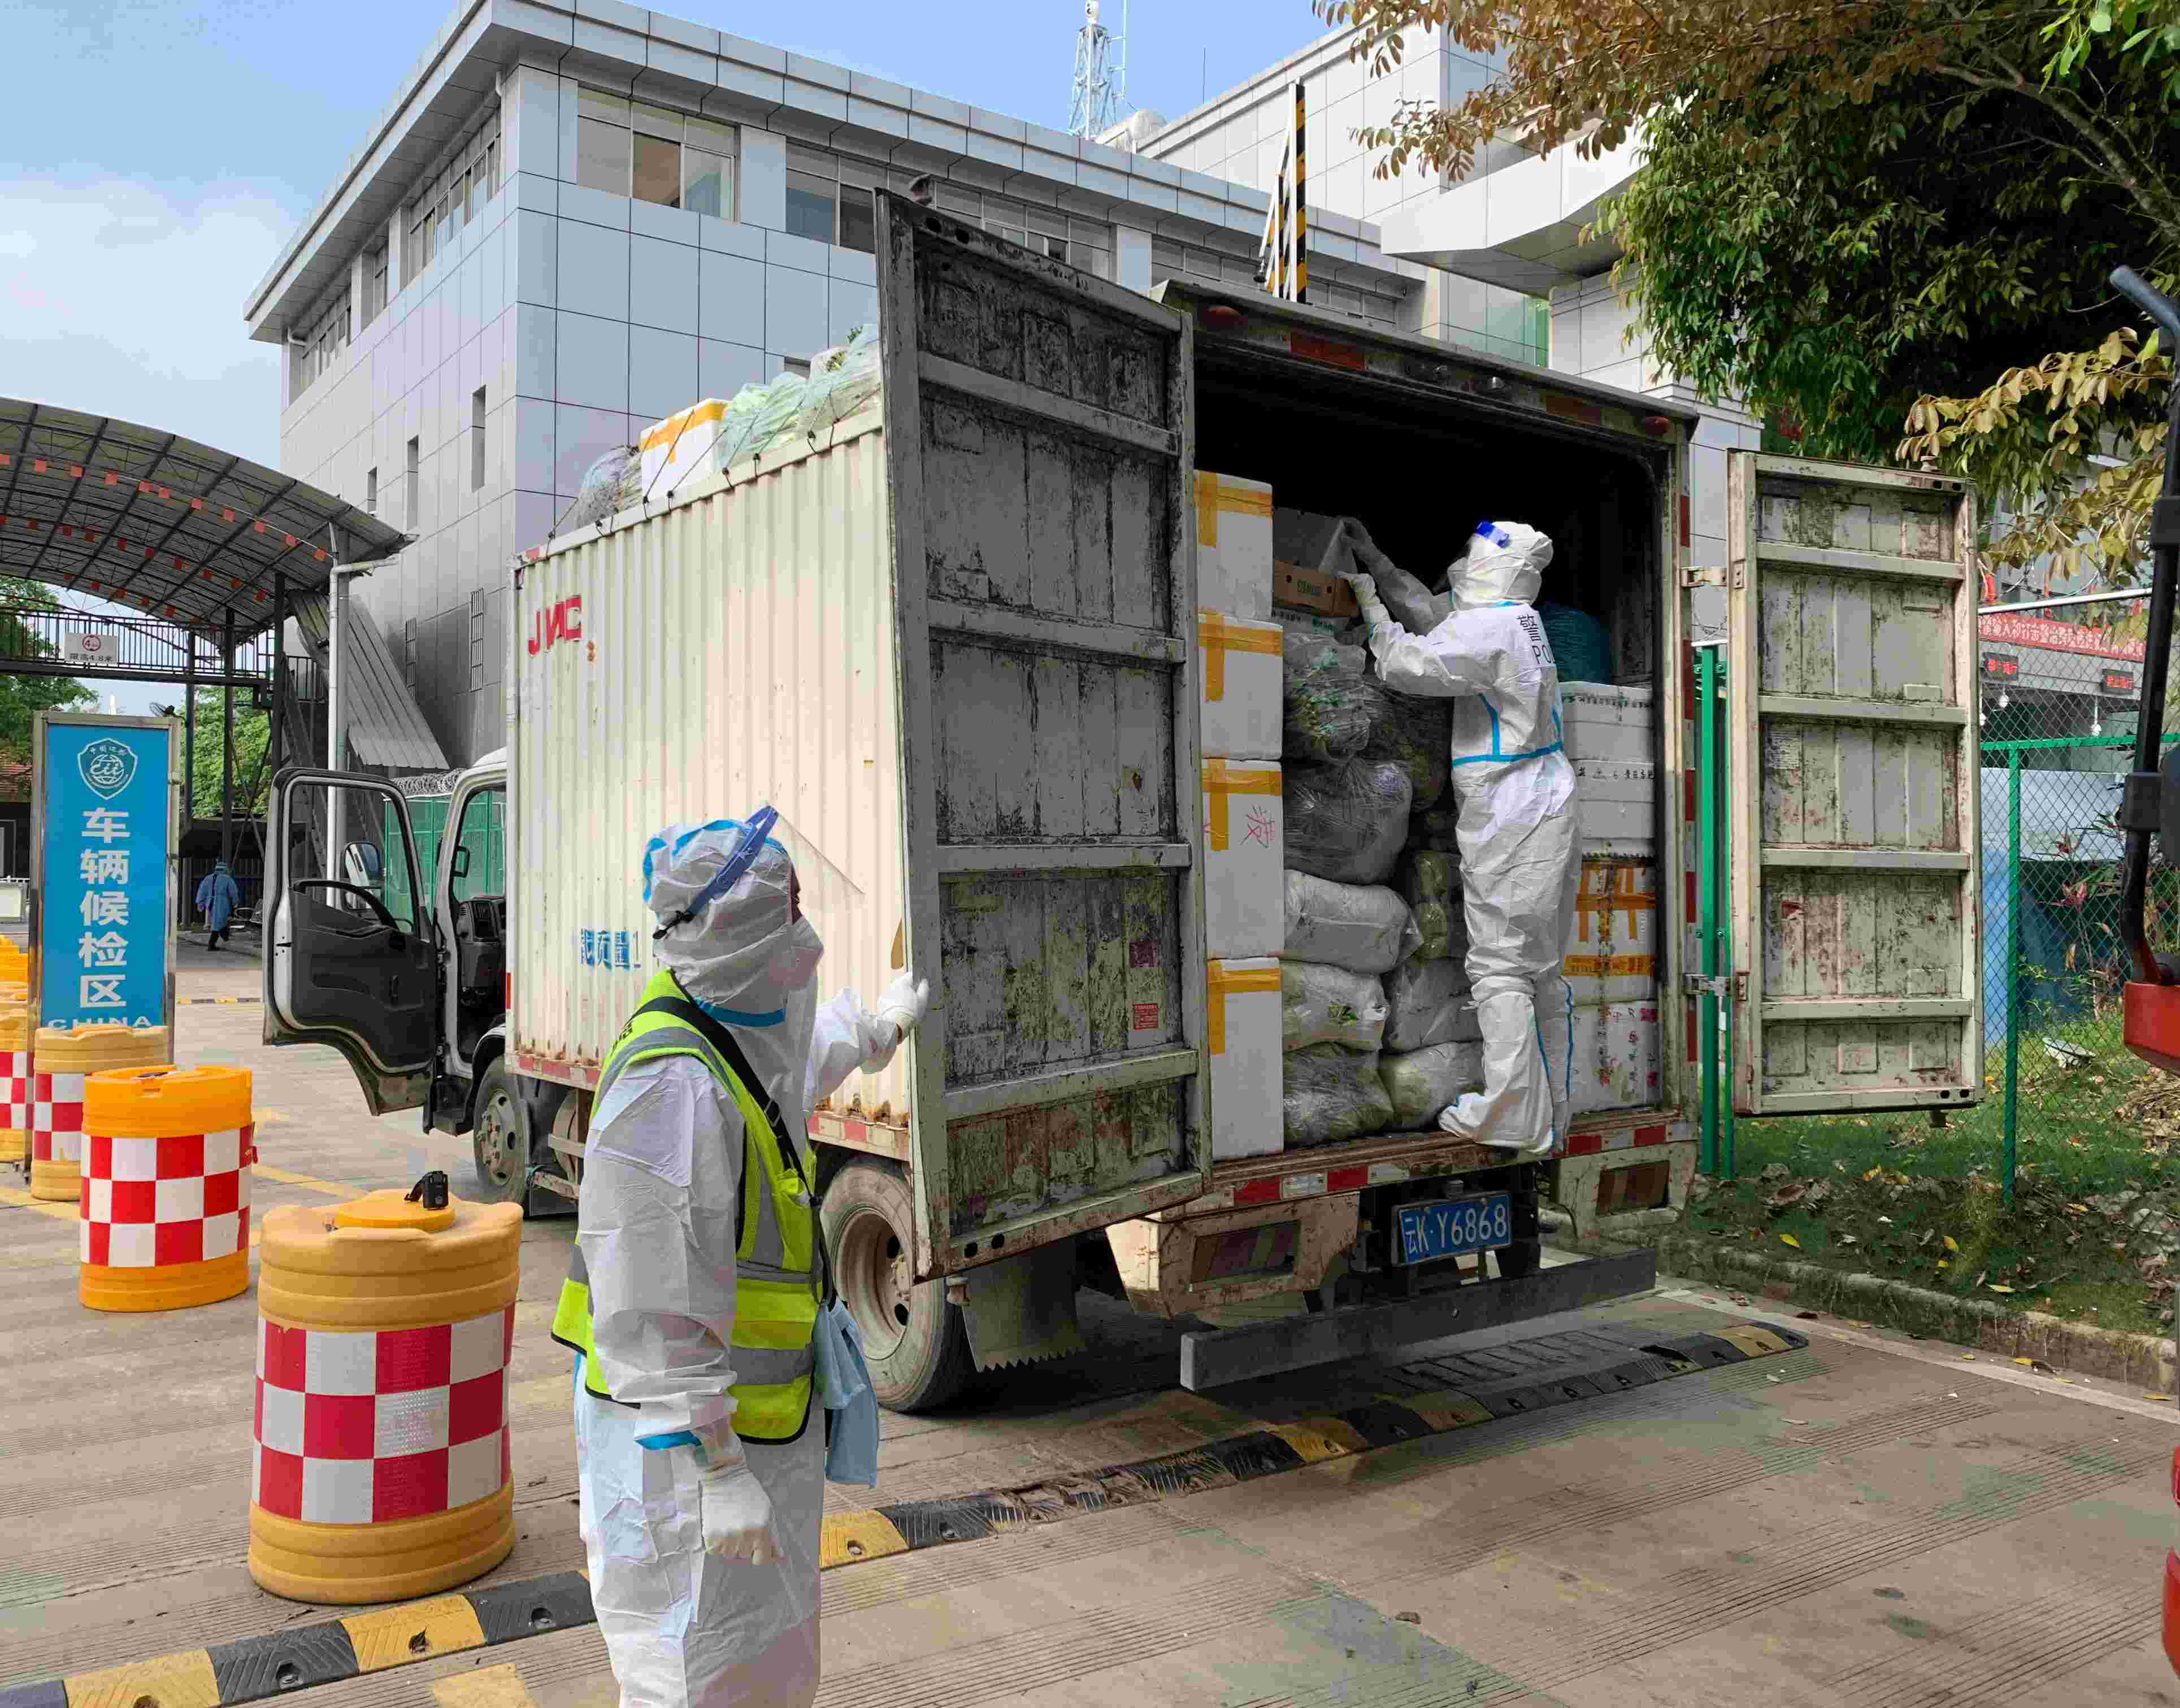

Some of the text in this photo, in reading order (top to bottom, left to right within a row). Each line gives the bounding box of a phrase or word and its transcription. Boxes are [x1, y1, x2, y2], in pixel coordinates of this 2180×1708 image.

[1517, 614, 1542, 642] 警
[78, 807, 131, 1009] 车辆候检区
